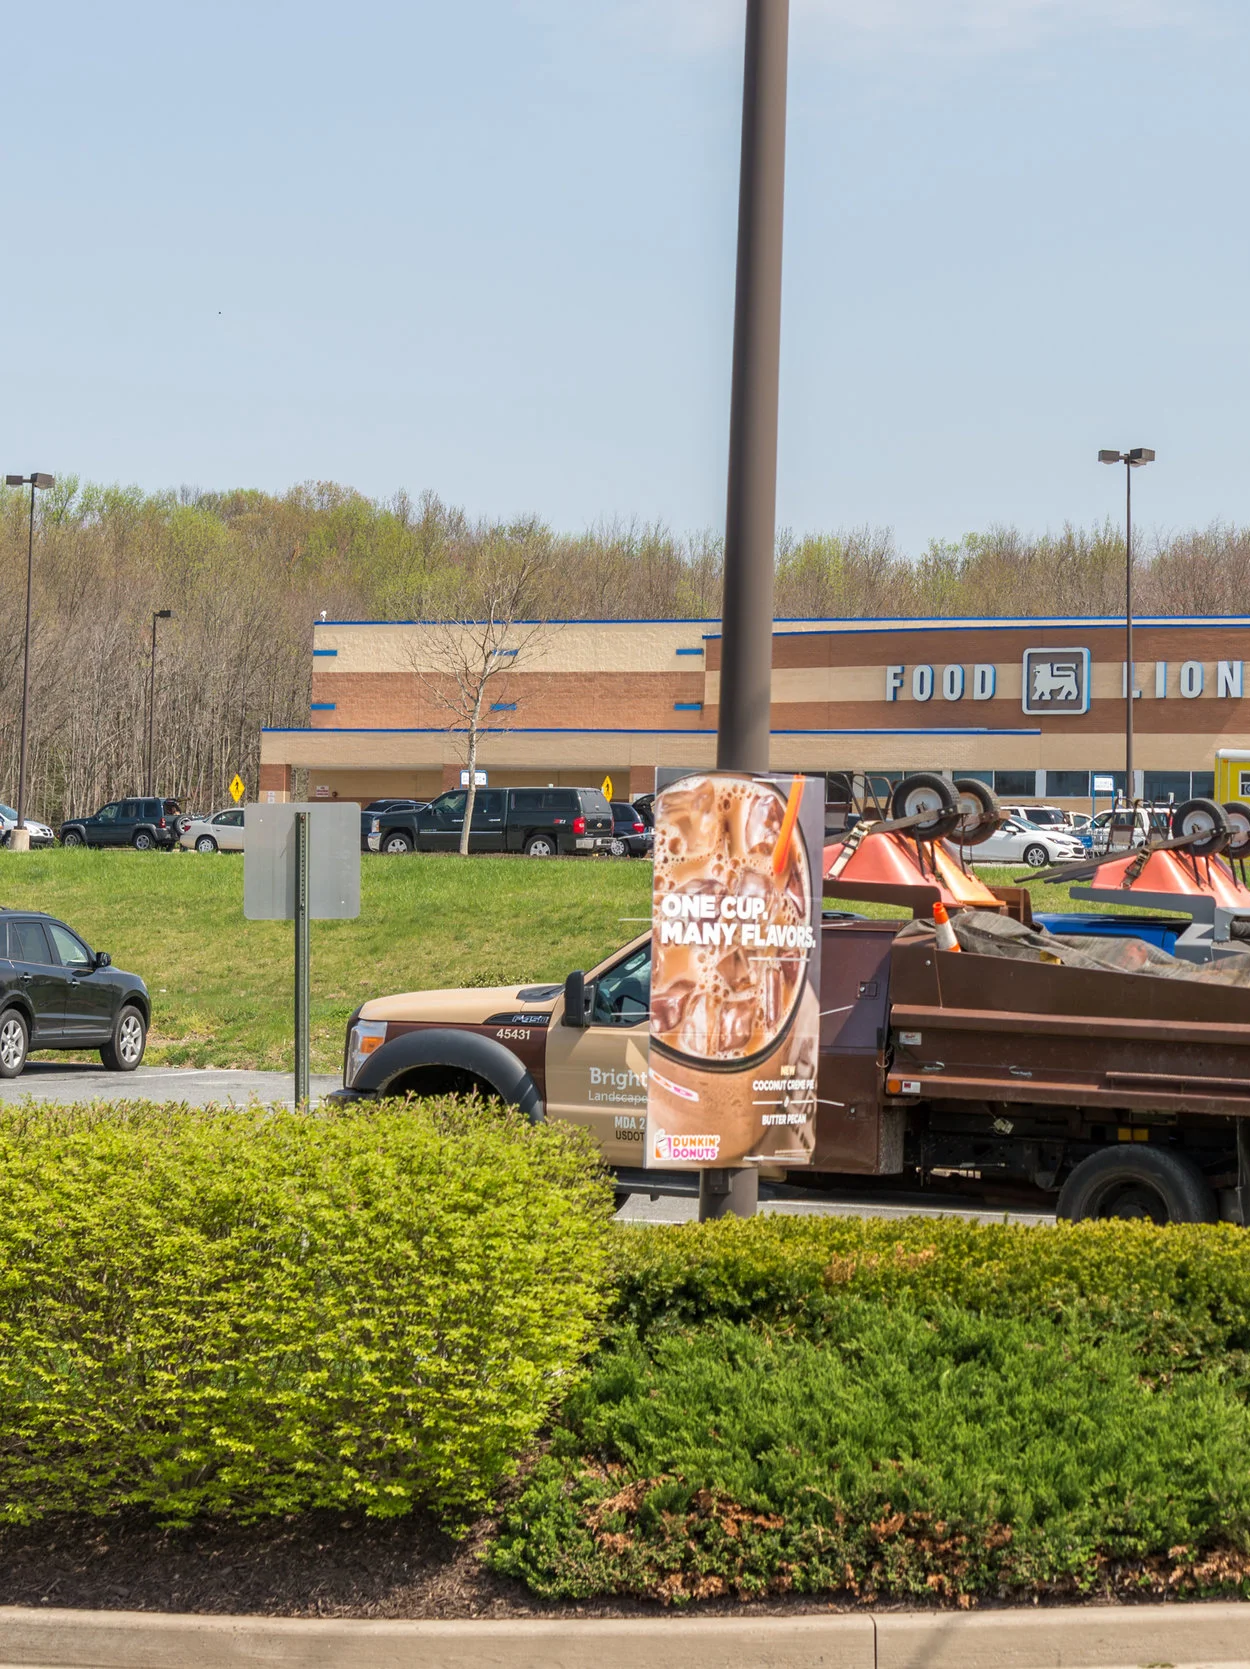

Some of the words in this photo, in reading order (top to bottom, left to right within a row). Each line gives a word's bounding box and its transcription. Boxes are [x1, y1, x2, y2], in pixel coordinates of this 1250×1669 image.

[886, 664, 997, 702] FOOD
[1122, 660, 1245, 699] LION
[661, 894, 717, 919] ONE
[720, 896, 768, 920] CUP.
[661, 922, 737, 946] MANY
[741, 924, 817, 948] FLAVORS.
[496, 1028, 531, 1040] 45431
[780, 1065, 797, 1077] NEW
[589, 1066, 648, 1091] Bright
[752, 1080, 787, 1091] COCONUT
[588, 1090, 648, 1106] Landscape
[614, 1115, 637, 1129] MDA
[761, 1114, 787, 1126] BUTTER
[787, 1113, 808, 1125] PECAN
[615, 1130, 646, 1142] USDOT
[673, 1137, 719, 1147] DUNKIN'
[673, 1148, 717, 1158] DONUTS
